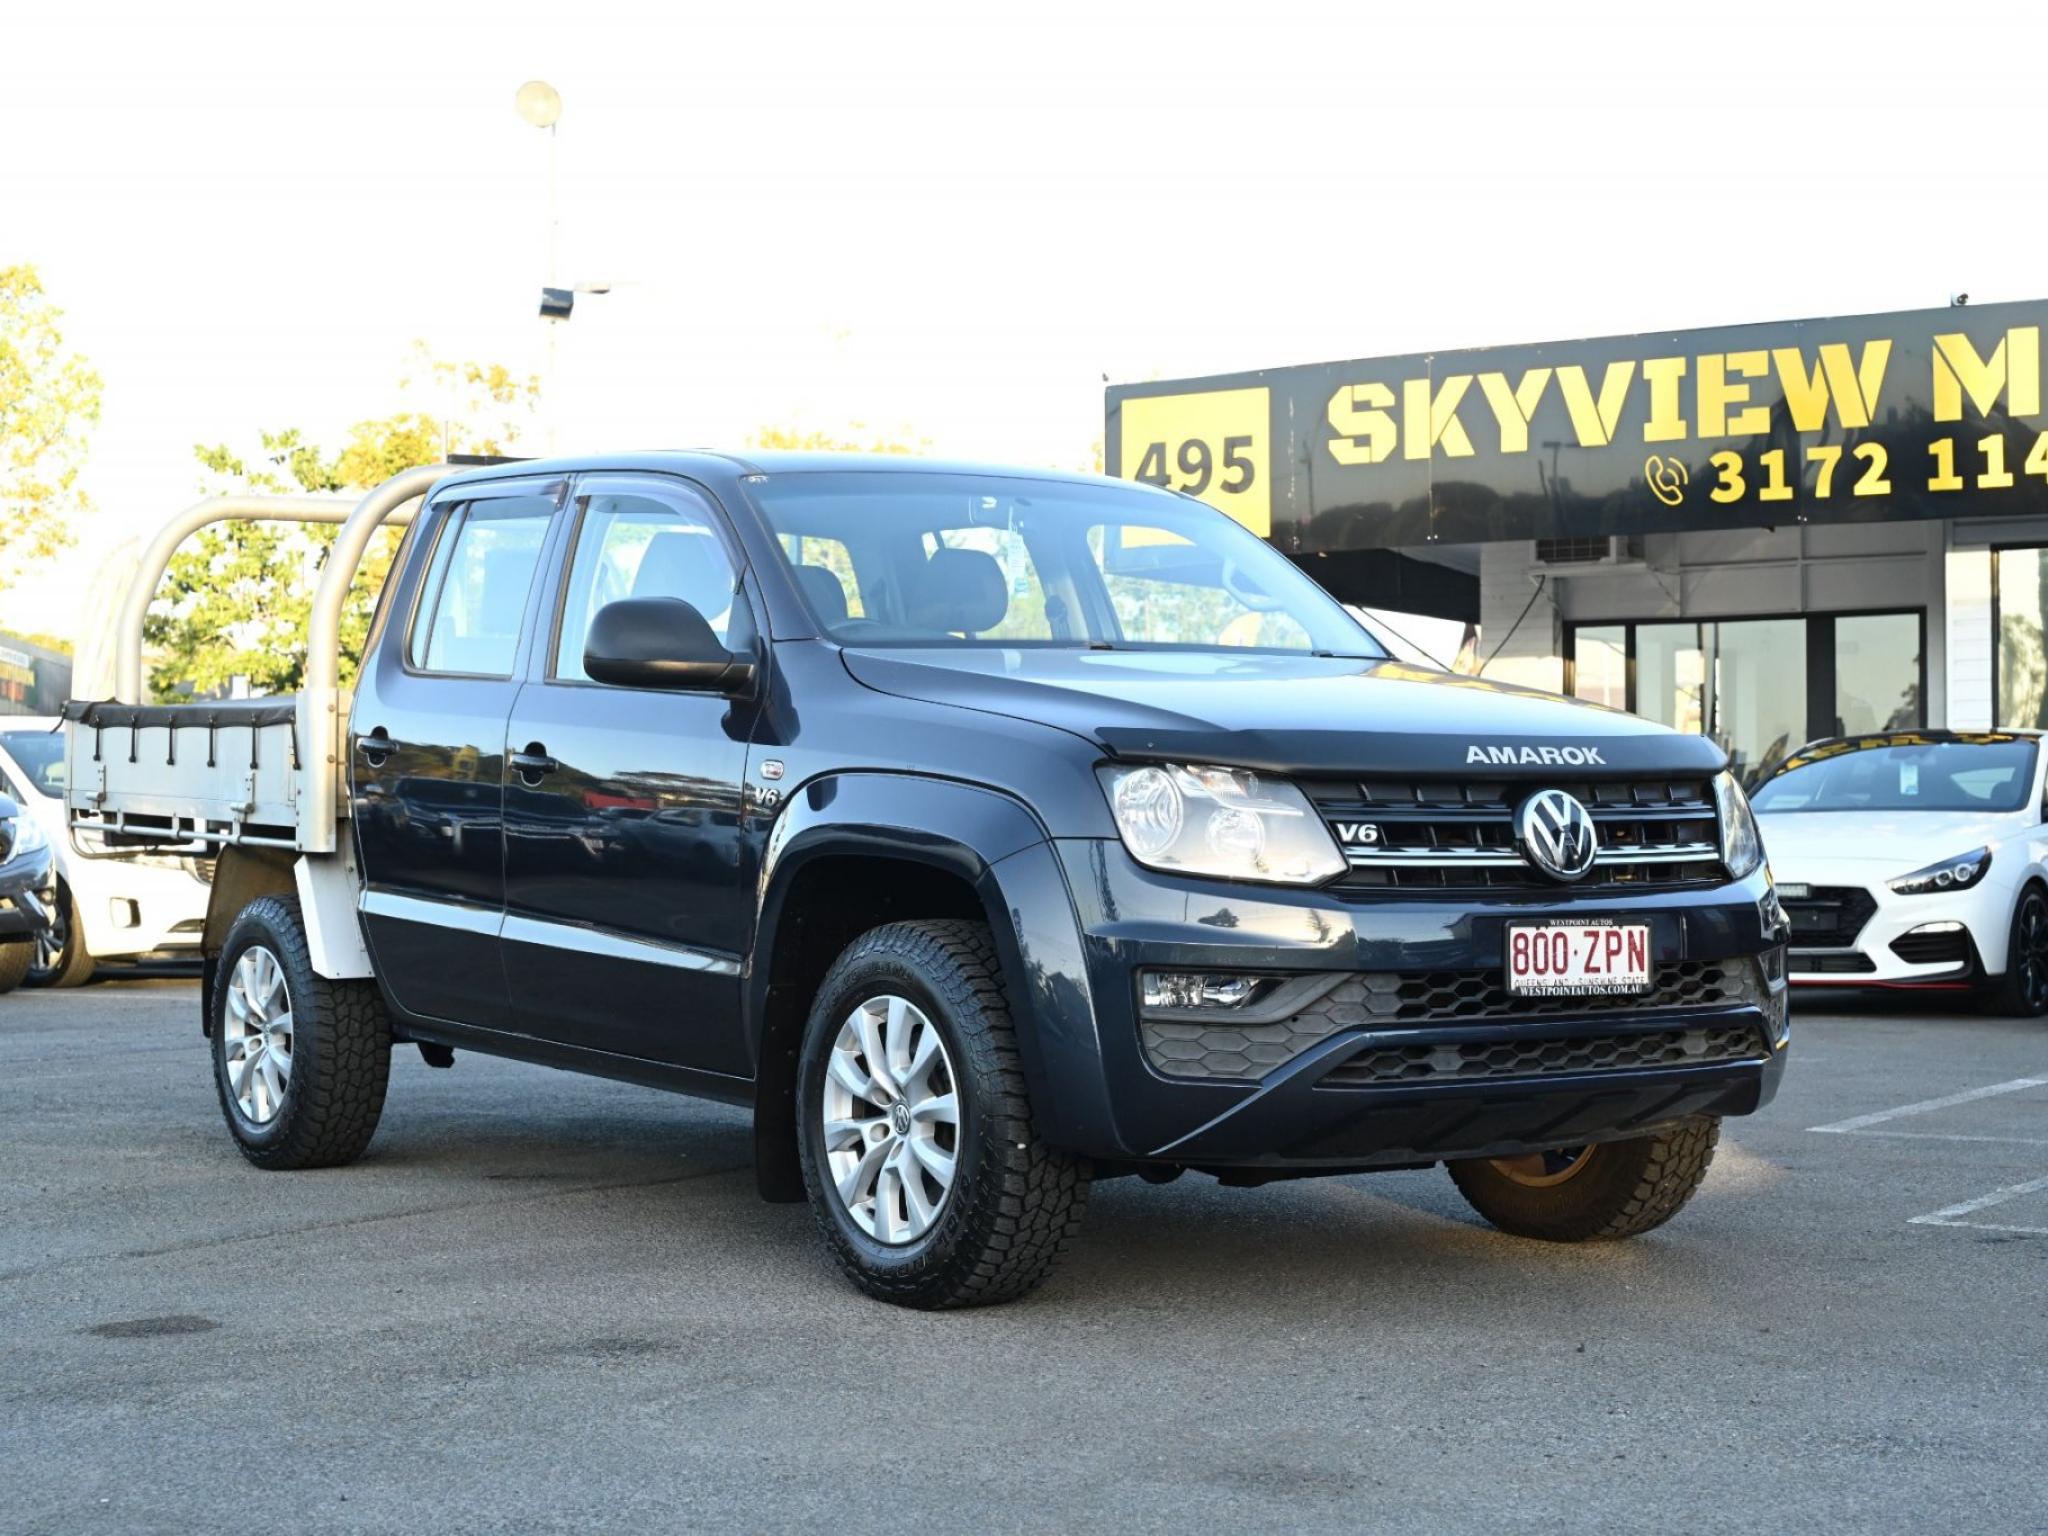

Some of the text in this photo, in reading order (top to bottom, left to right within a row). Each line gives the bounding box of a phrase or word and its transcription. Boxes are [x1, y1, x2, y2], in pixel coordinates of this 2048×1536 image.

[1327, 339, 1893, 465] SKYVIEW
[1134, 434, 1256, 498] 495
[1709, 441, 1892, 503] 3172
[1466, 744, 1607, 766] AMAROK
[755, 787, 779, 807] V6
[1335, 823, 1379, 843] V6
